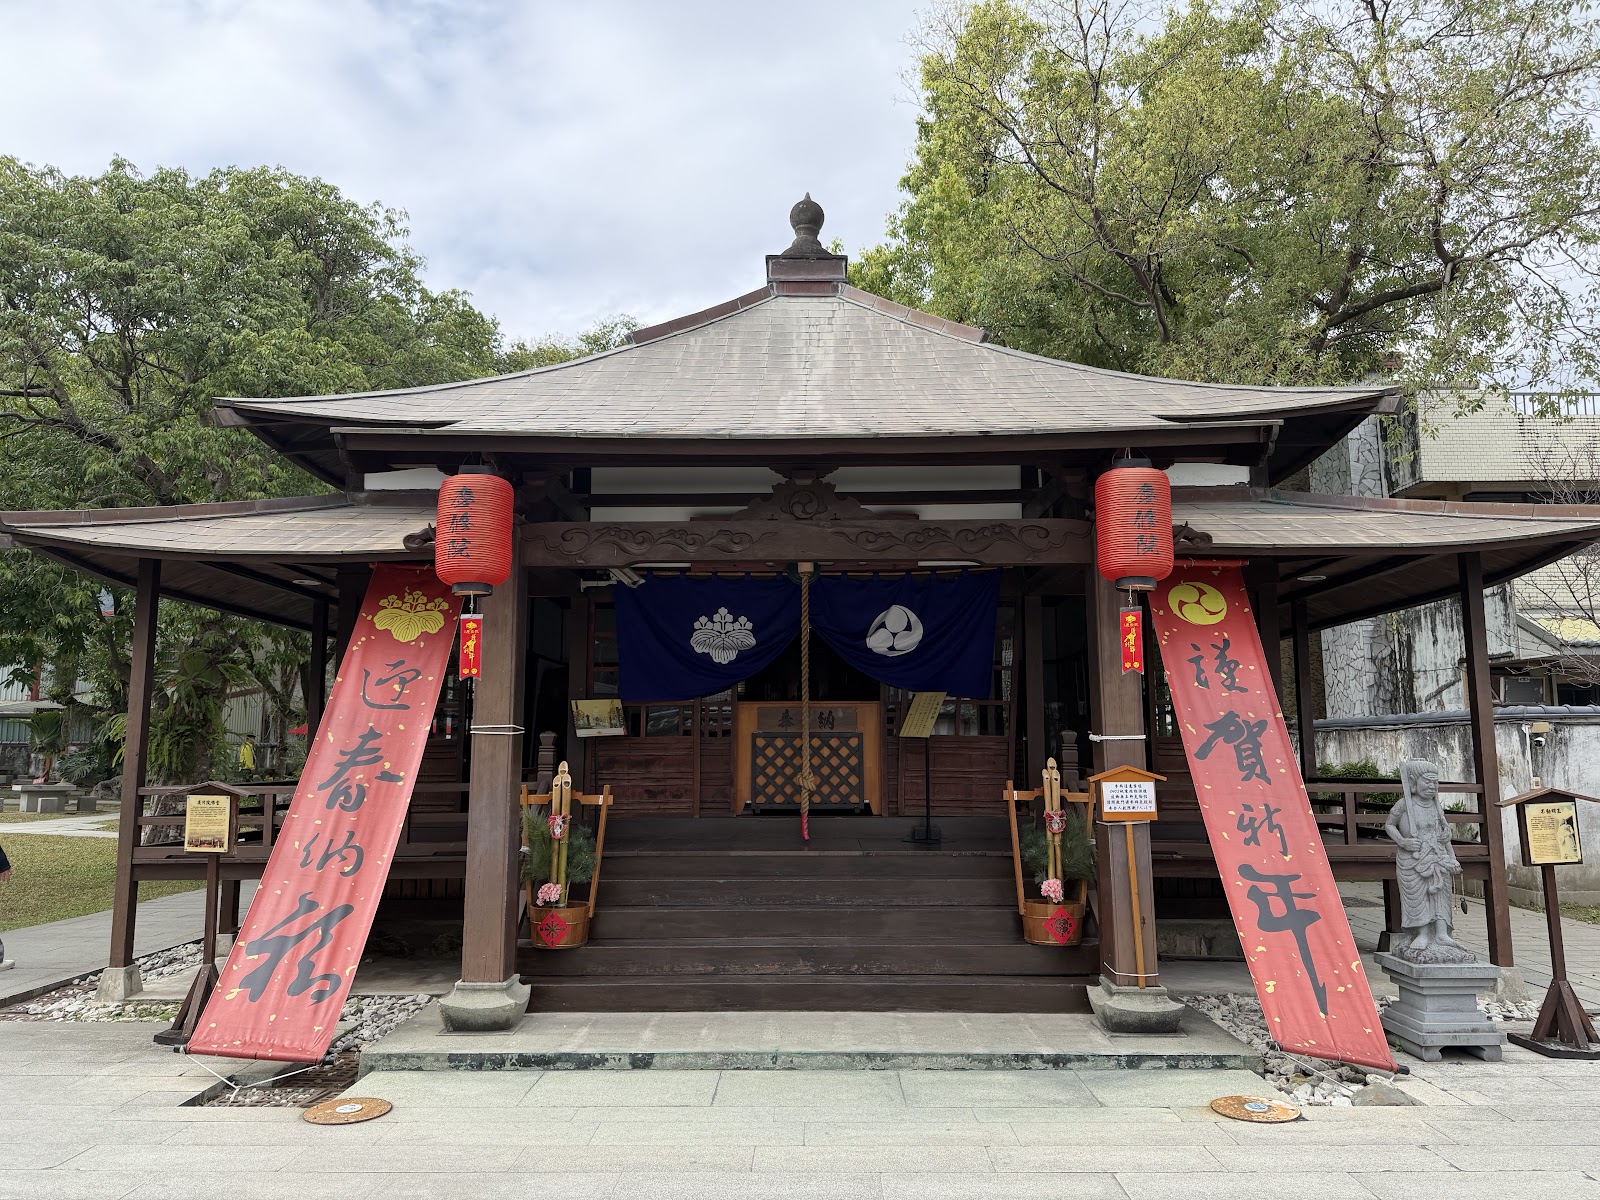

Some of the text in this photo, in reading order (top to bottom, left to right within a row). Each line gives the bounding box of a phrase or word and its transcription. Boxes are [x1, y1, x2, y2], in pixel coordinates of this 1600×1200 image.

[1133, 483, 1160, 555] 慶修院
[238, 659, 423, 1007] 迎春納福
[1186, 638, 1328, 1017] 謹賀新年
